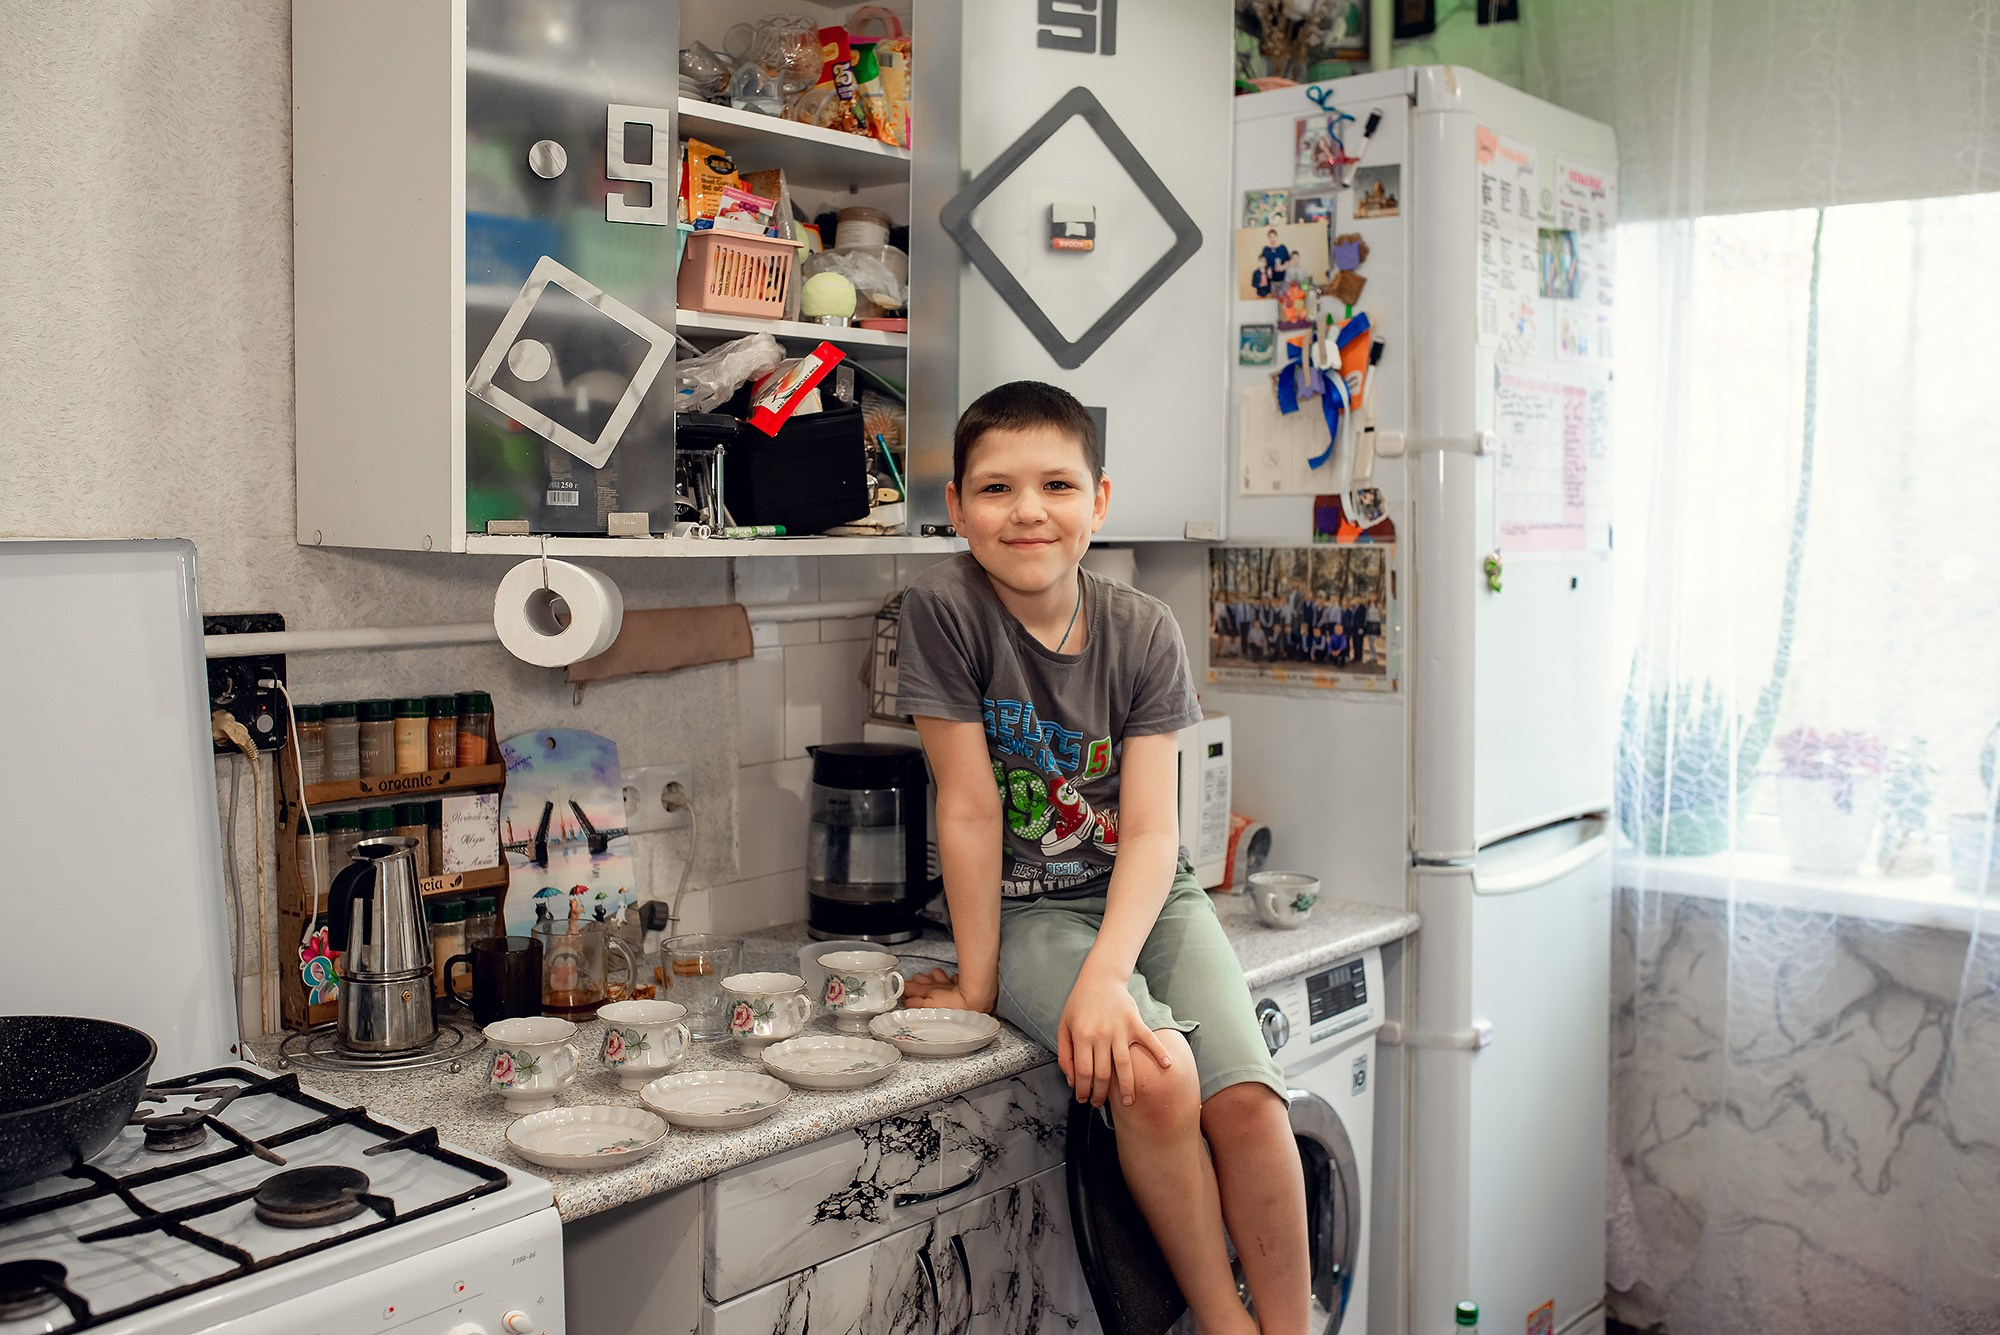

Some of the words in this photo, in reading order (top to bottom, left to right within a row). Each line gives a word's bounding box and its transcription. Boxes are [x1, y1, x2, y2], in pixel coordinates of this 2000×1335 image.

[1090, 743, 1109, 774] 5
[379, 774, 432, 792] organic
[1012, 862, 1042, 879] BEST
